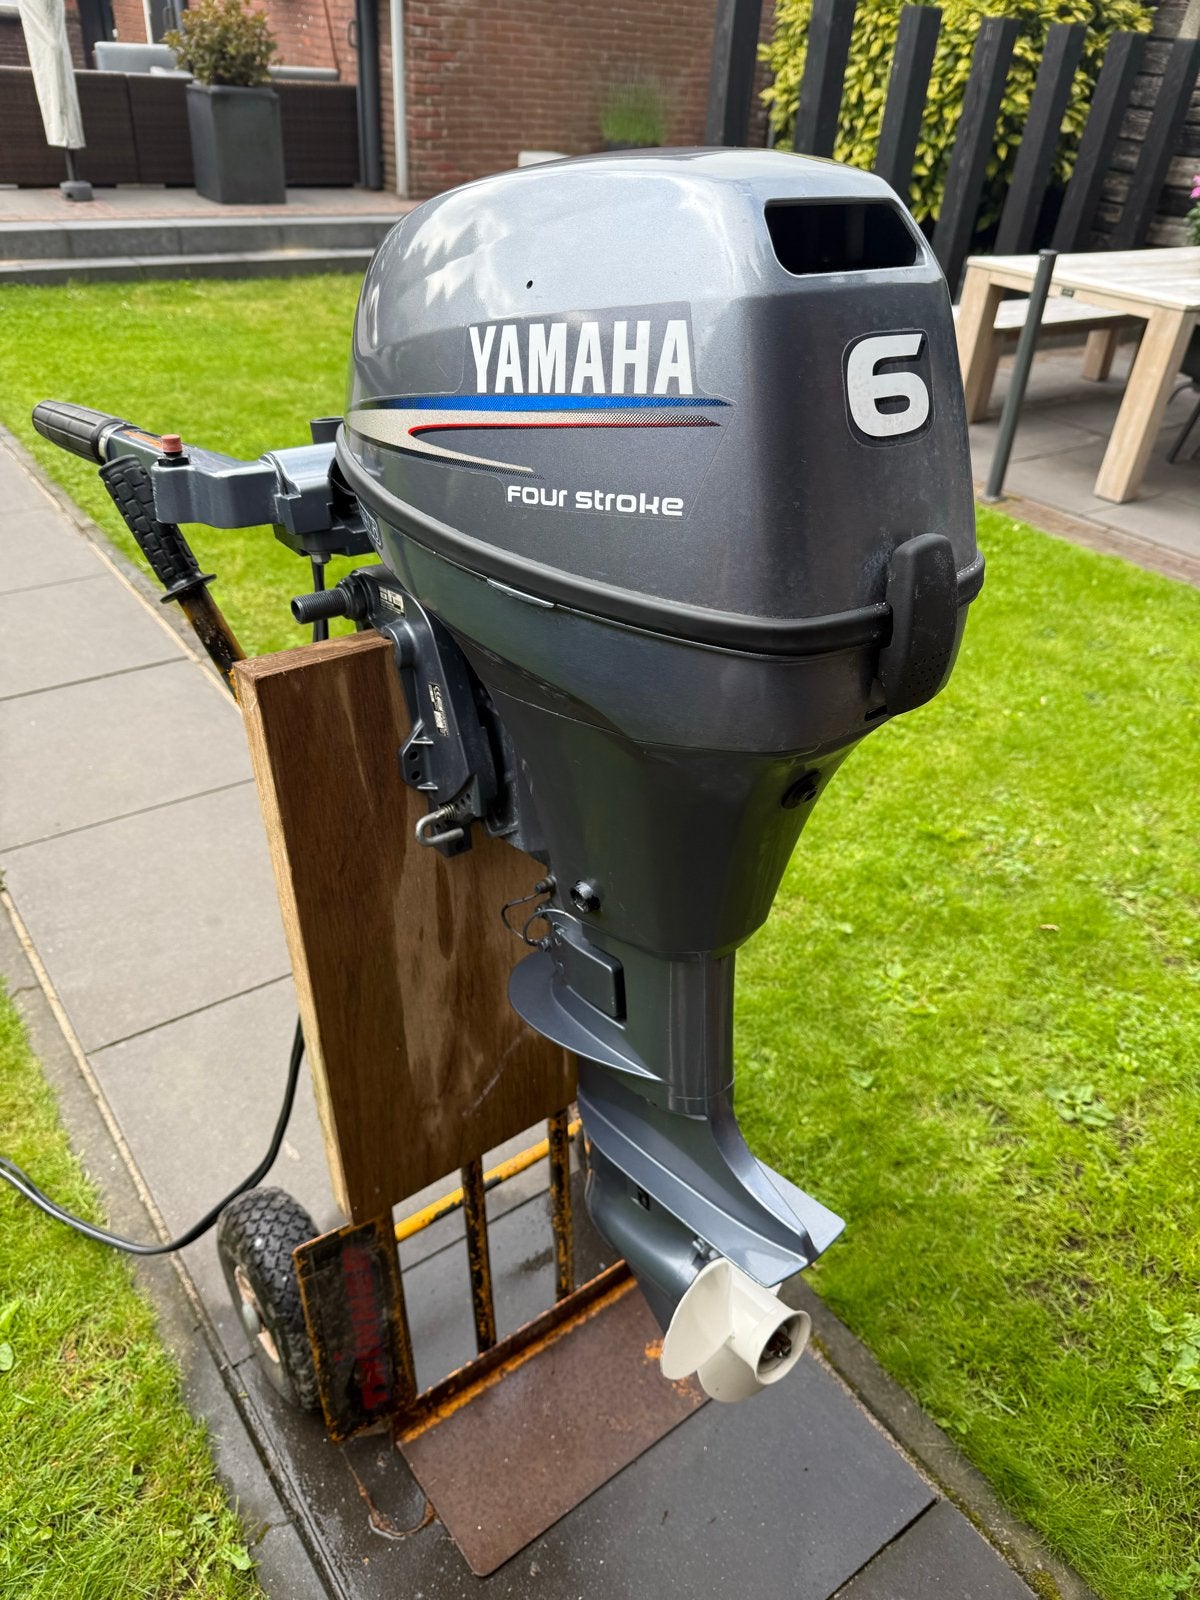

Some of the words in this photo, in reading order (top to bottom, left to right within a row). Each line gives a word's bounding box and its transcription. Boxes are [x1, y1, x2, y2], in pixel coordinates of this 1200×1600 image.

[469, 320, 693, 394] YAMAHA
[847, 334, 930, 437] 6
[575, 489, 684, 517] stroke
